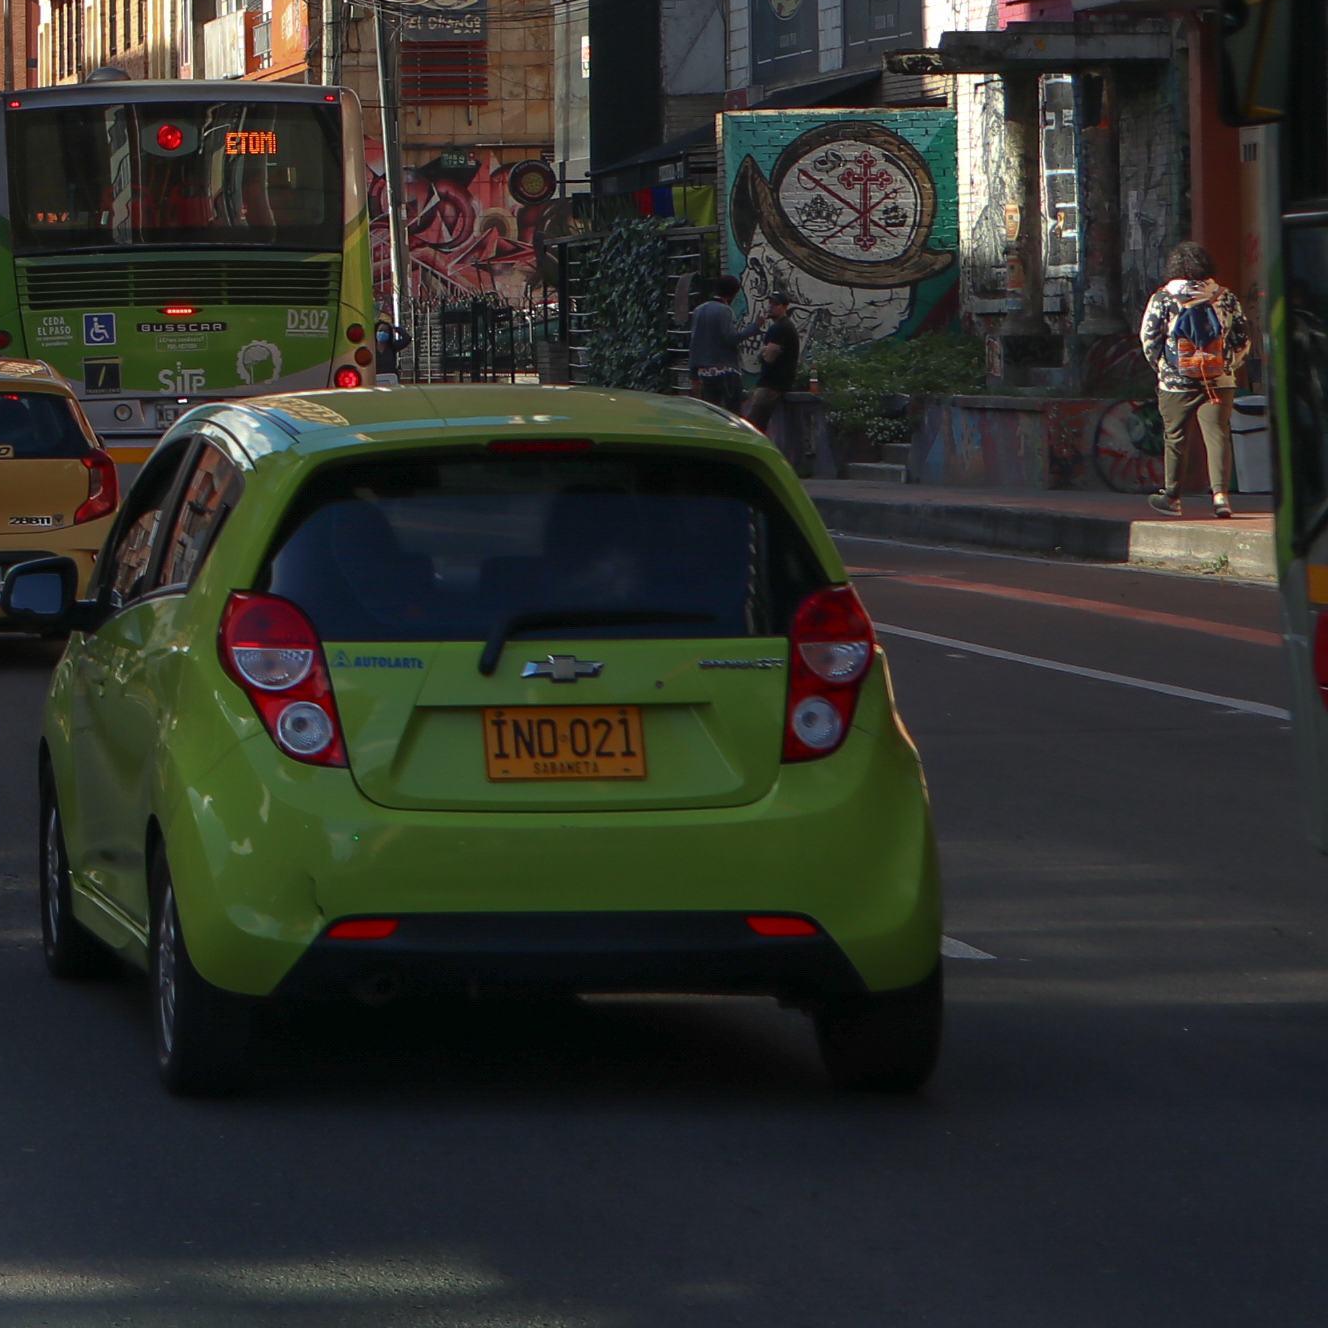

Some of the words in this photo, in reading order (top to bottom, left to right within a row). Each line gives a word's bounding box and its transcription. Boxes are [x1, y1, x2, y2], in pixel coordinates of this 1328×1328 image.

[43, 316, 65, 326] CEDA
[287, 308, 329, 330] D502
[37, 327, 47, 336] EL
[49, 325, 71, 335] PASO
[141, 323, 222, 332] BUSSCAR
[9, 517, 50, 525] 28811
